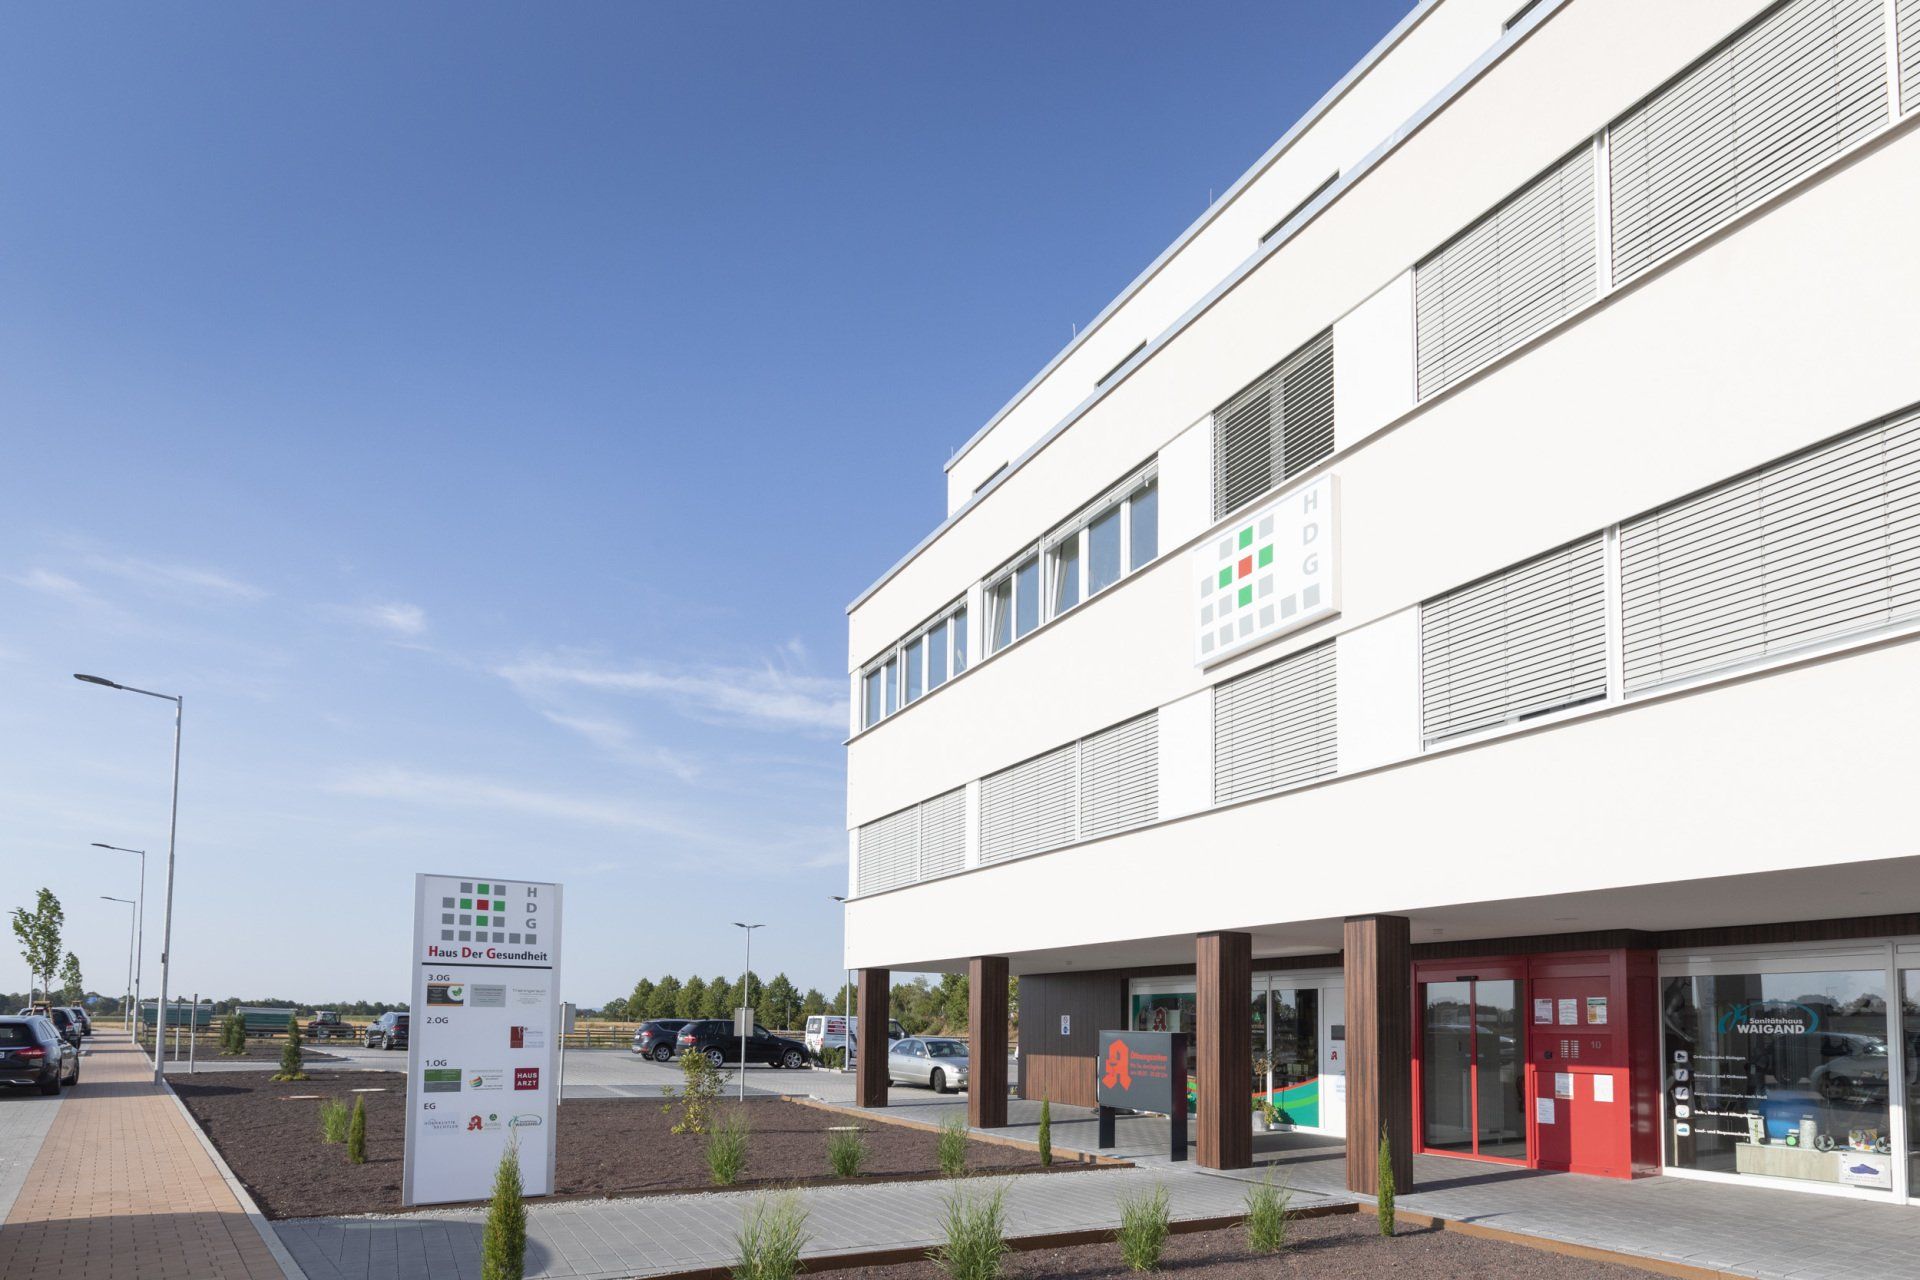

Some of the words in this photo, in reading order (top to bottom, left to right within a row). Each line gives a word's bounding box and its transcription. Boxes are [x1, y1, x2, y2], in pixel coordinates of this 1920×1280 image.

[428, 945, 458, 958] Haus
[461, 947, 484, 959] Der
[486, 948, 548, 961] Gesundheit
[428, 974, 450, 982] 3.OG
[426, 1016, 449, 1025] 2.OG
[1749, 1017, 1803, 1025] Sanitätshaus
[1737, 1024, 1806, 1034] WAIGAND
[425, 1059, 447, 1067] 1.OG
[423, 1102, 436, 1110] EG
